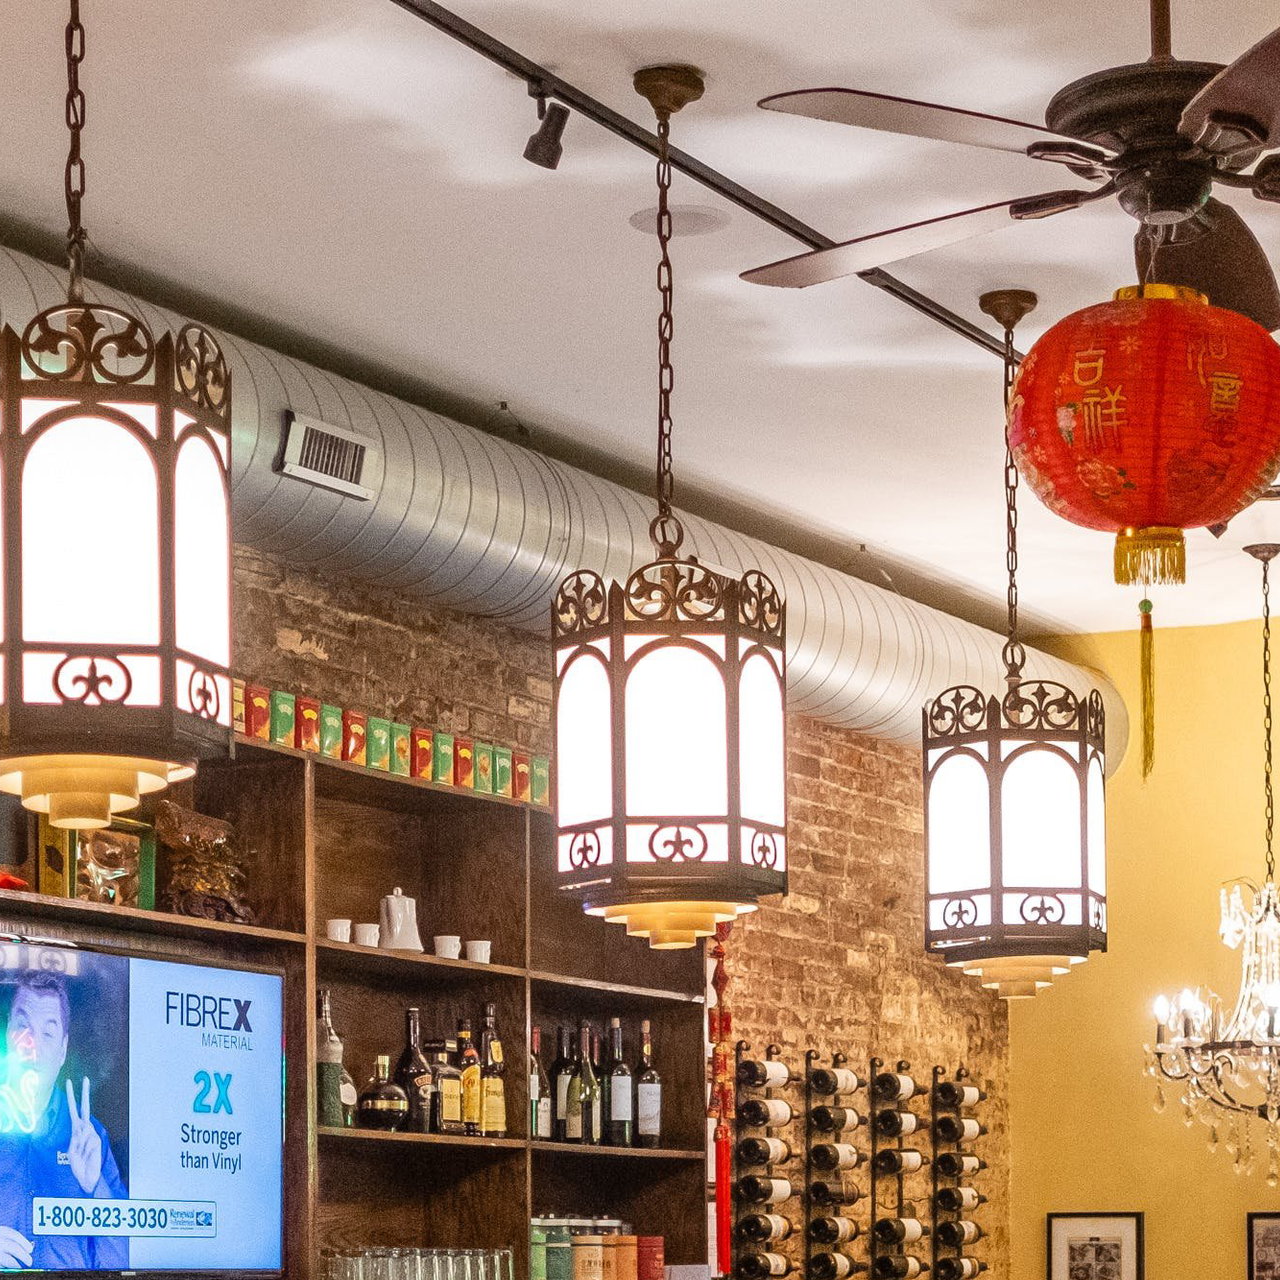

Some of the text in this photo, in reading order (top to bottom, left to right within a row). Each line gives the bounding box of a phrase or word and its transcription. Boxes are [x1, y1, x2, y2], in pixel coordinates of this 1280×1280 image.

[166, 990, 252, 1033] FIBREX
[201, 1032, 254, 1051] MATERIAL
[193, 1070, 233, 1115] 2X
[180, 1123, 242, 1150] Stronger
[180, 1150, 242, 1174] than Vinyl
[37, 1206, 168, 1229] 1-800-823-3030
